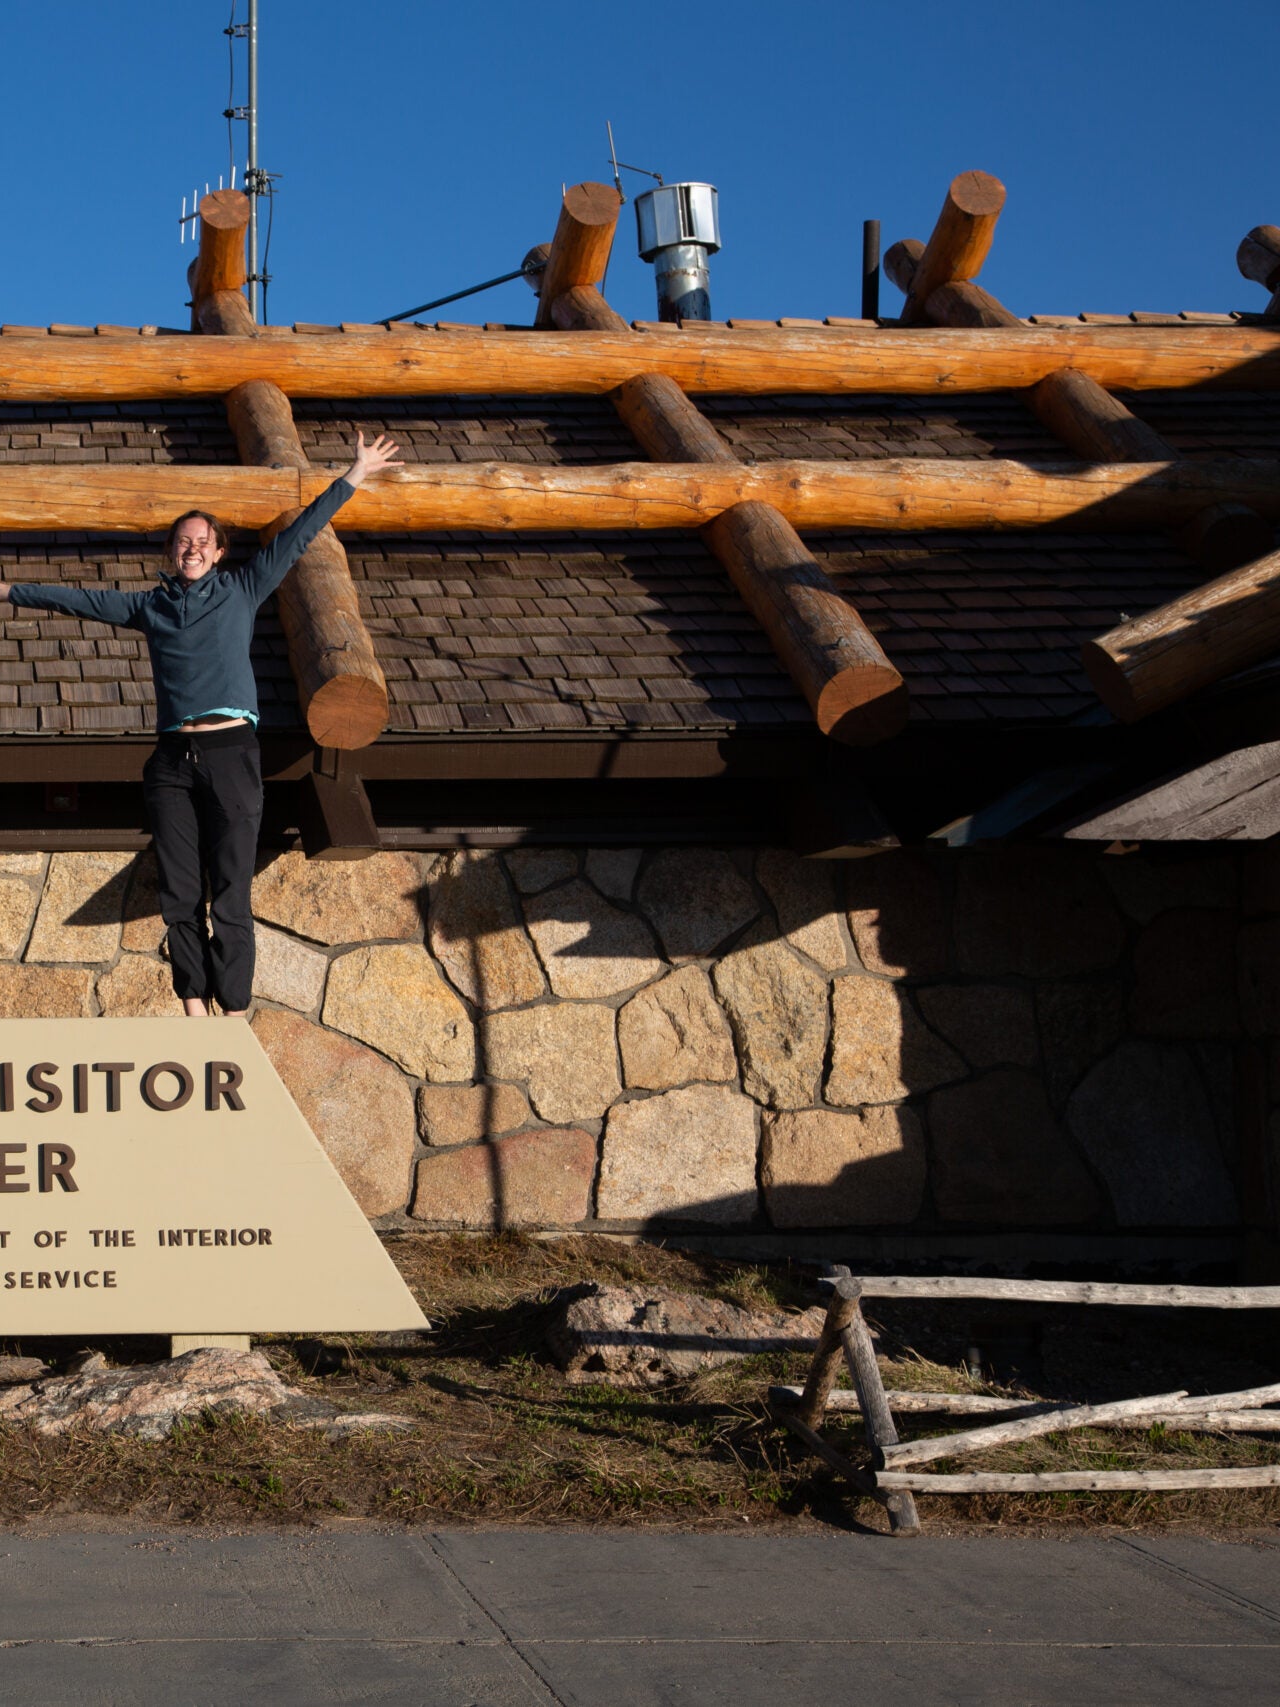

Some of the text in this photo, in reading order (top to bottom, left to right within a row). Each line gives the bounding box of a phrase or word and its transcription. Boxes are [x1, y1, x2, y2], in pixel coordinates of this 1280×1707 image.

[34, 1231, 68, 1249] OF
[89, 1230, 135, 1248] THE
[159, 1229, 272, 1247] INTERIOR
[4, 1270, 117, 1290] SERVICE
